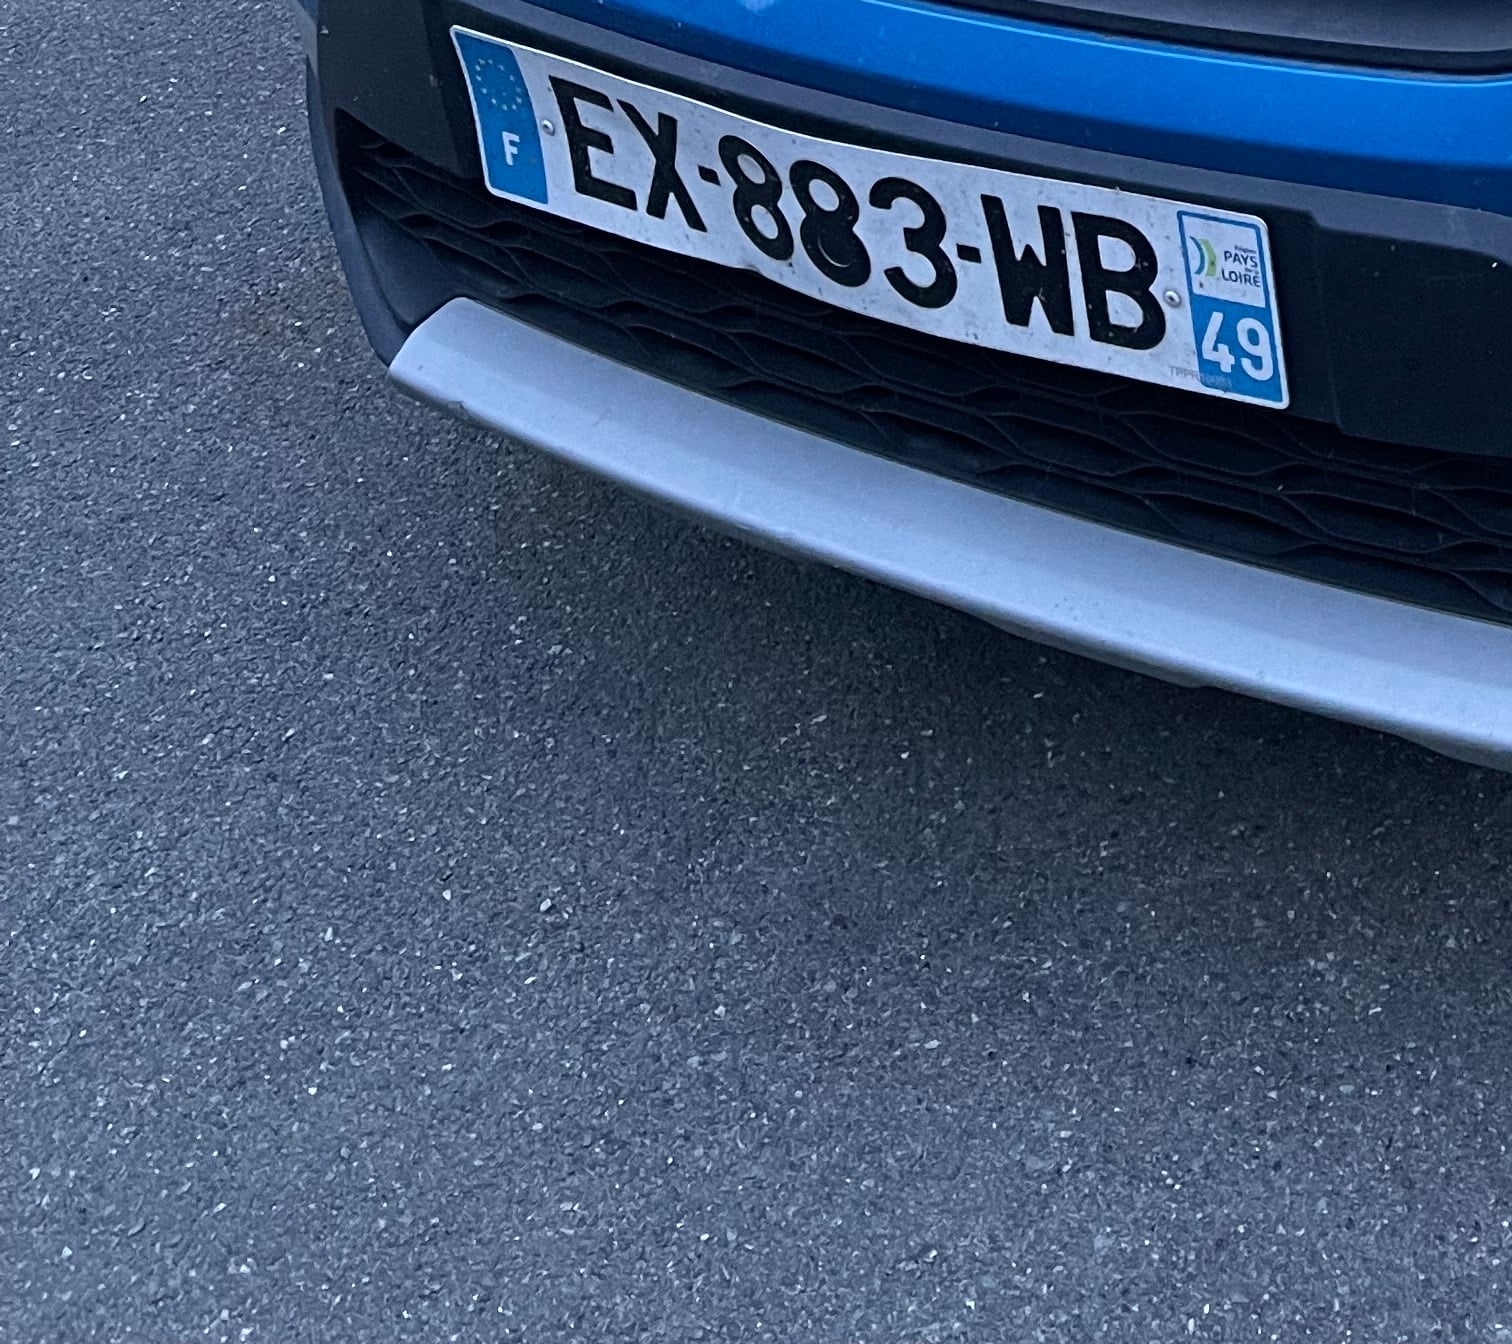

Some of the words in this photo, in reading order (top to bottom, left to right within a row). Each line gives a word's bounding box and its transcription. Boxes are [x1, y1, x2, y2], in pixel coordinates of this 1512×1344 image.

[502, 131, 520, 166] F
[548, 74, 1166, 351] EX-883-WB
[1223, 250, 1258, 268] PAYS
[1221, 268, 1261, 288] LOIRE
[1202, 311, 1273, 381] 49
